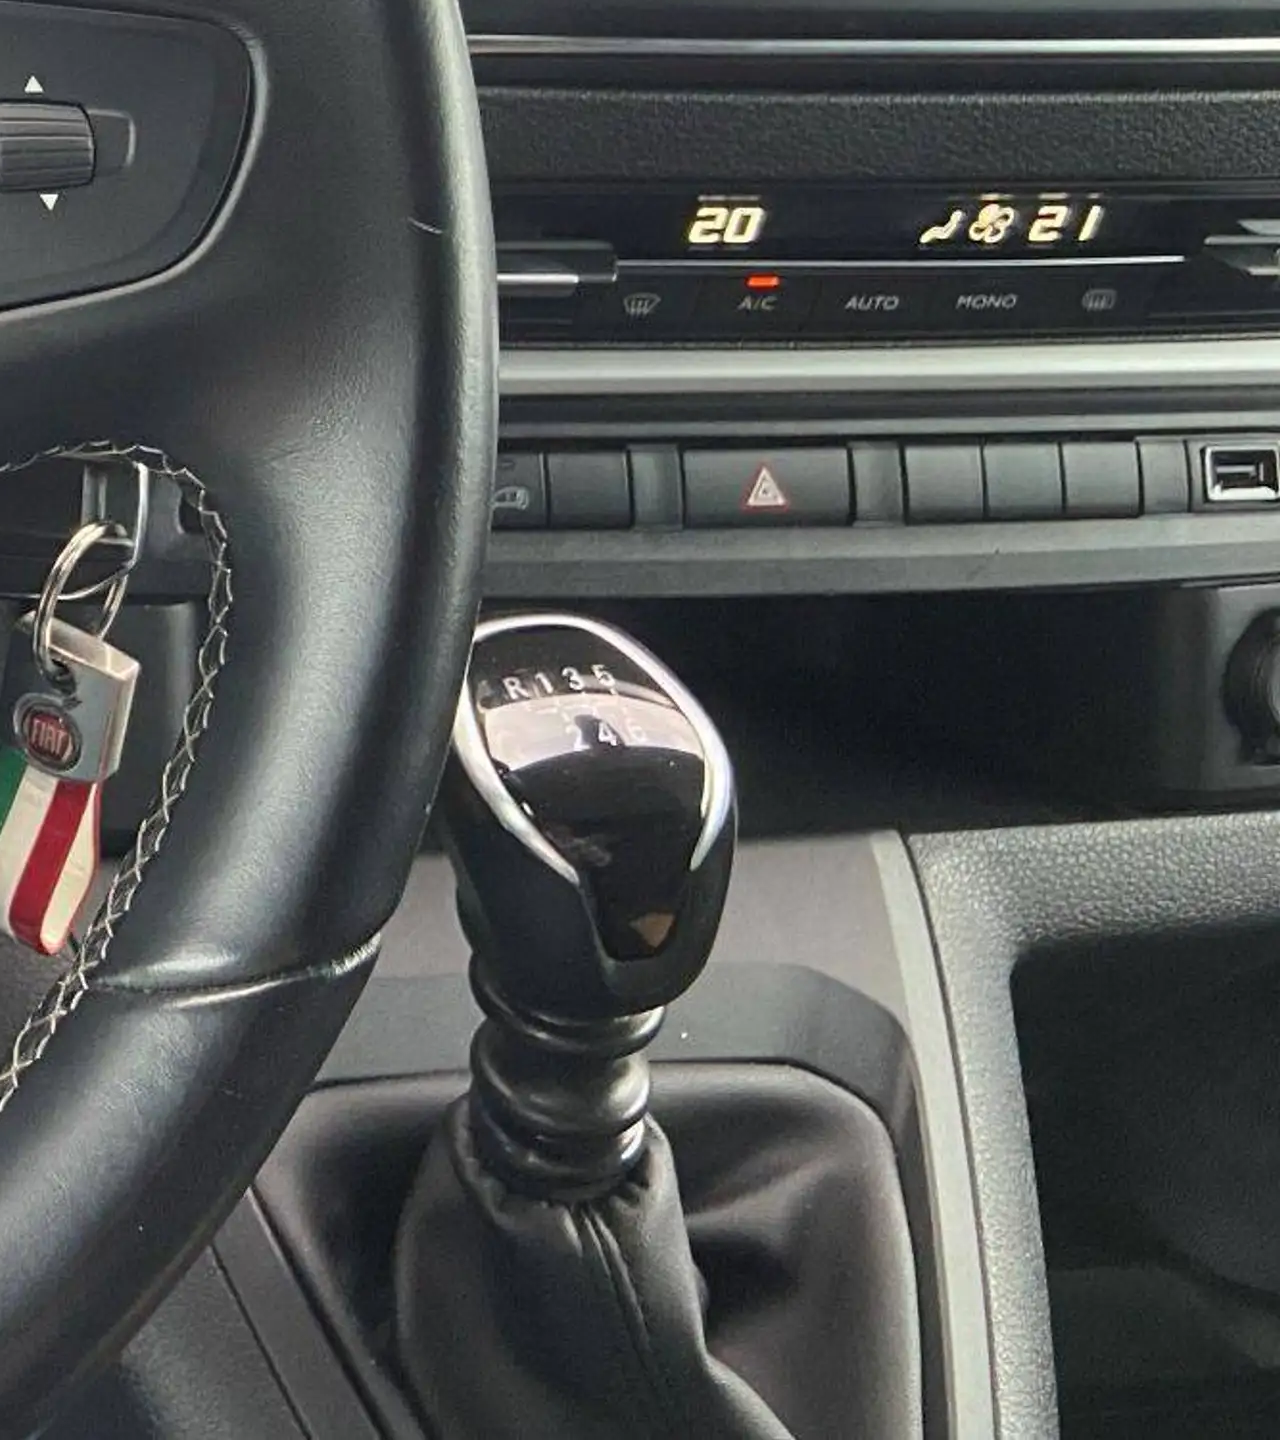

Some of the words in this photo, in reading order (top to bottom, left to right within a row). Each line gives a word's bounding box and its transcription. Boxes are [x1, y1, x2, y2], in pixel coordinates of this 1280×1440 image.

[688, 206, 766, 243] 20
[1028, 205, 1103, 243] 21
[738, 294, 777, 311] A/C
[844, 294, 899, 312] AUTO
[955, 293, 1019, 311] MONO
[502, 676, 530, 701] R
[535, 672, 554, 694] 1
[561, 666, 585, 691] 3
[591, 663, 617, 690] 5
[30, 717, 69, 757] FIAT
[597, 721, 619, 747] 4
